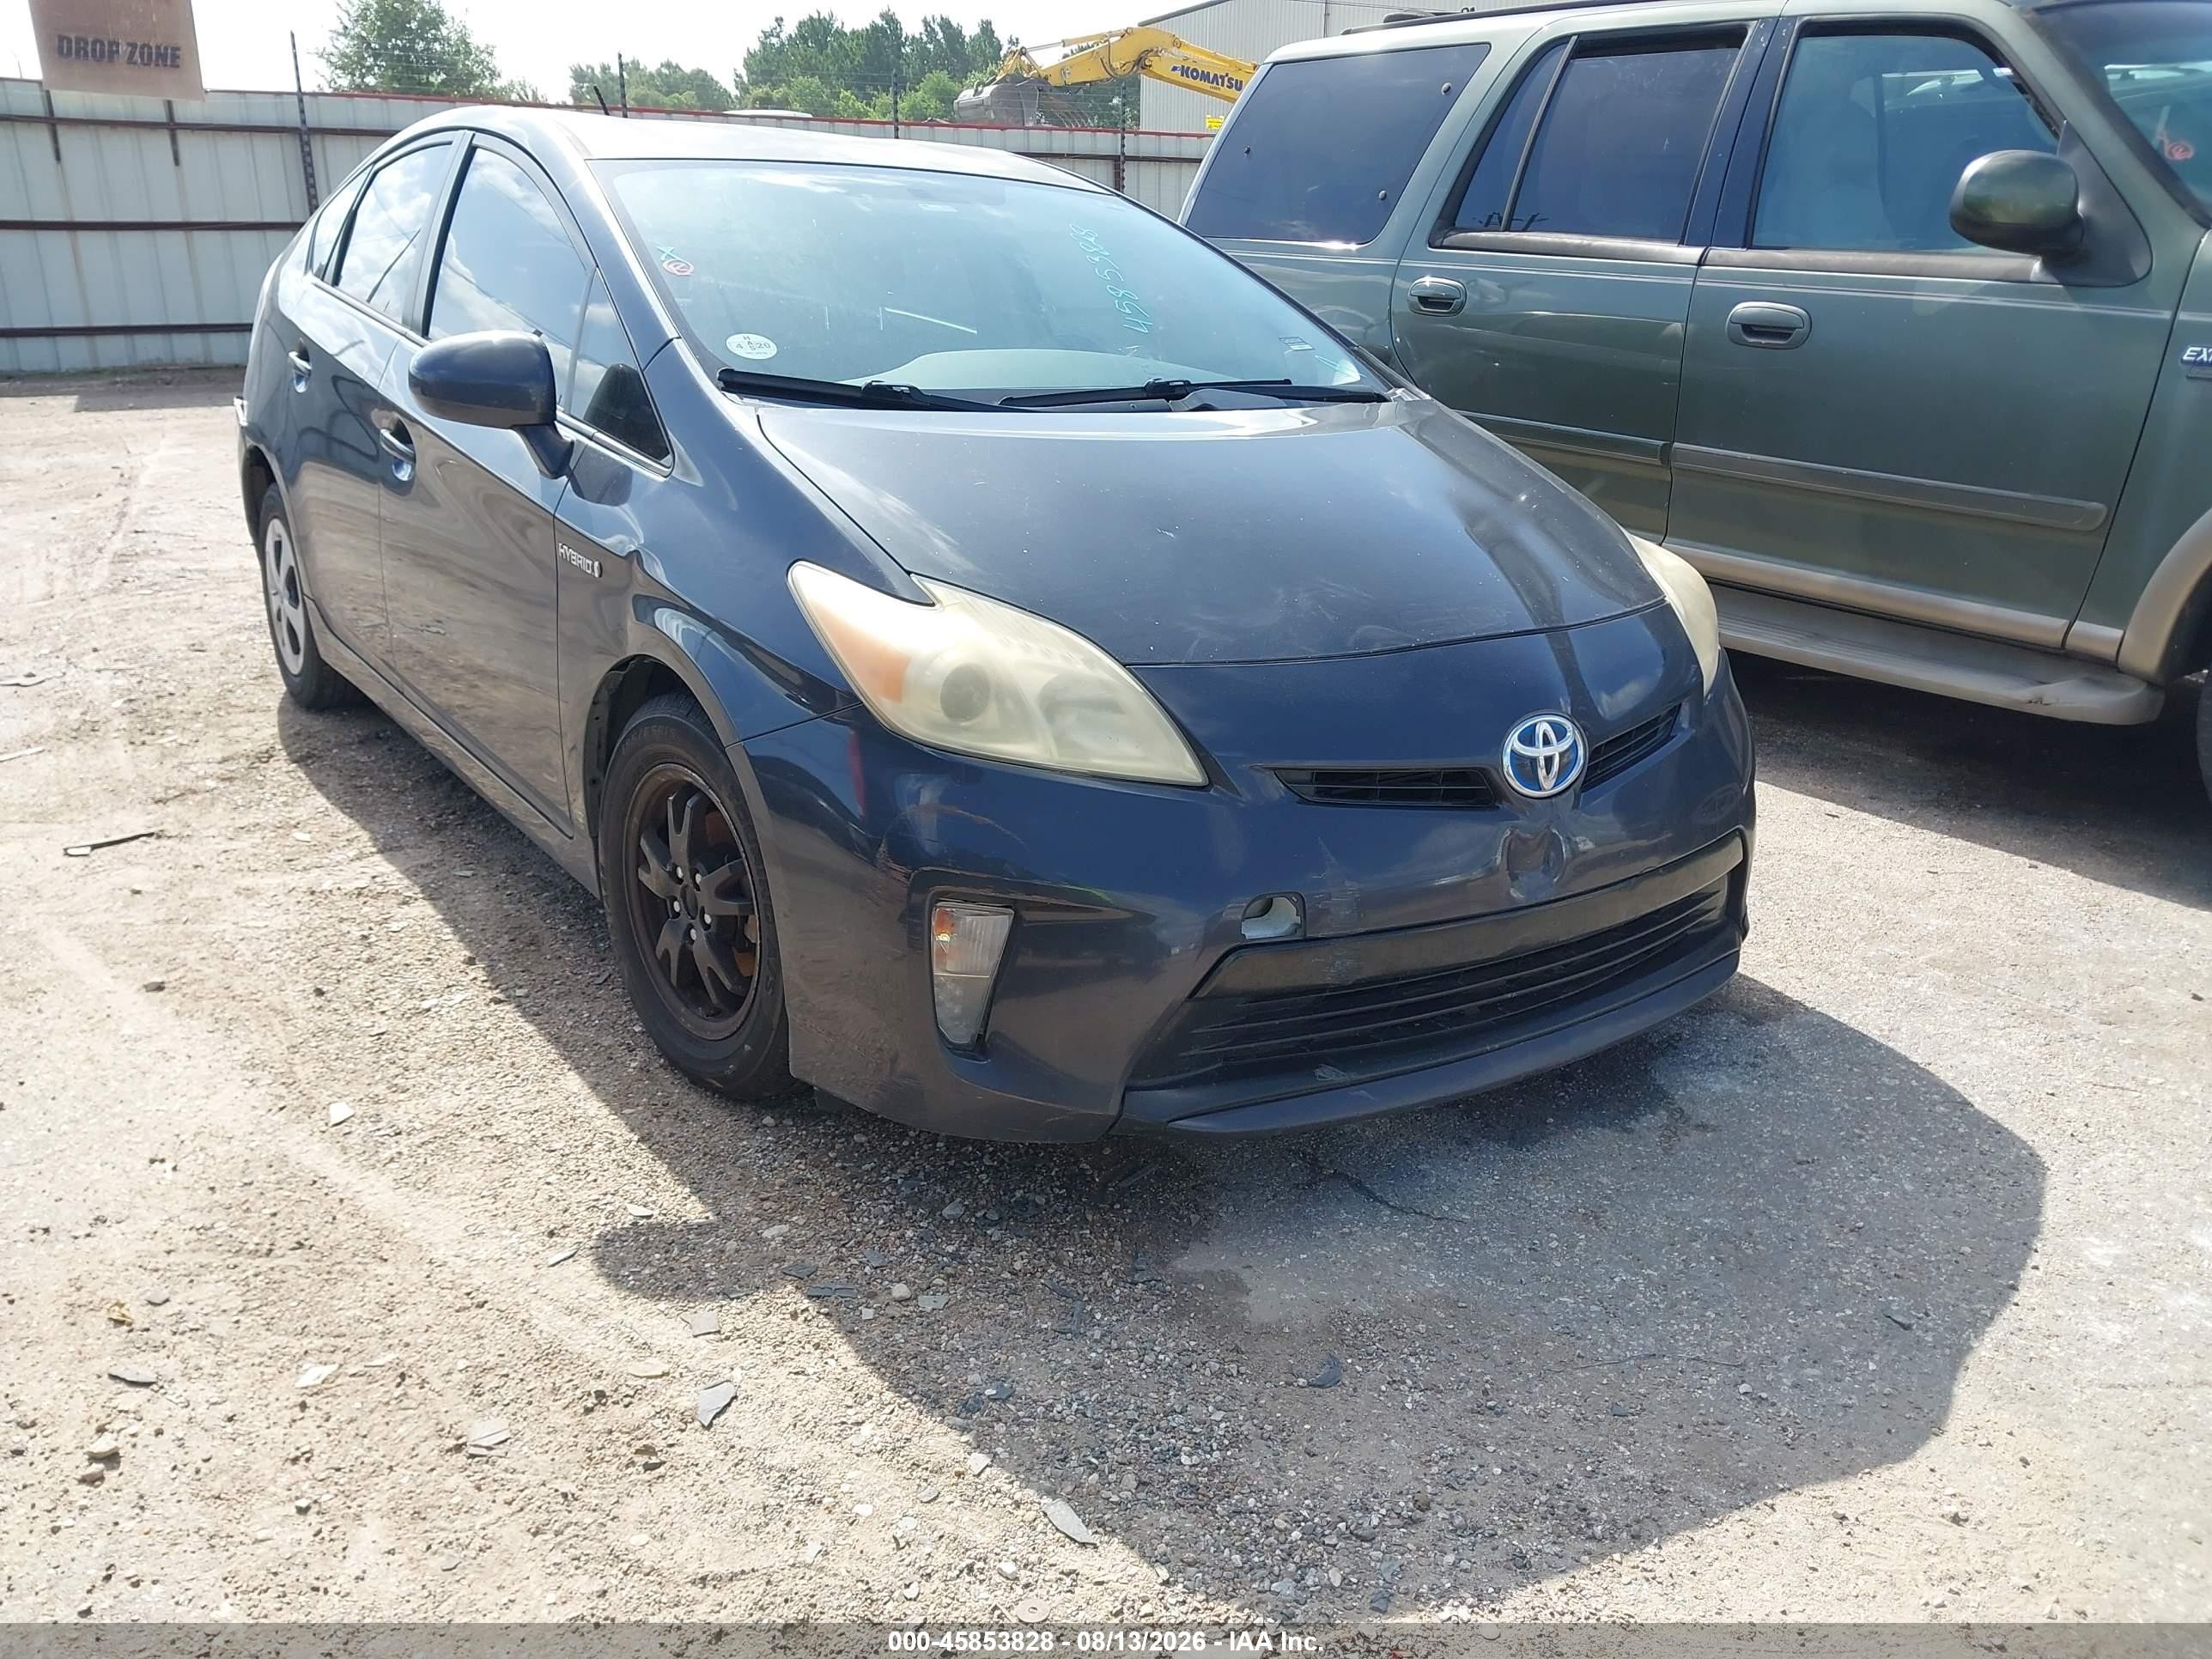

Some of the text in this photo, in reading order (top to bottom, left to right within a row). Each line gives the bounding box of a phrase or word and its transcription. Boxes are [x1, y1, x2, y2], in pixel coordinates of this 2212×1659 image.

[57, 35, 180, 68] DROP ZONE
[1180, 64, 1243, 92] KOMATSU
[558, 543, 593, 574] HYBRID
